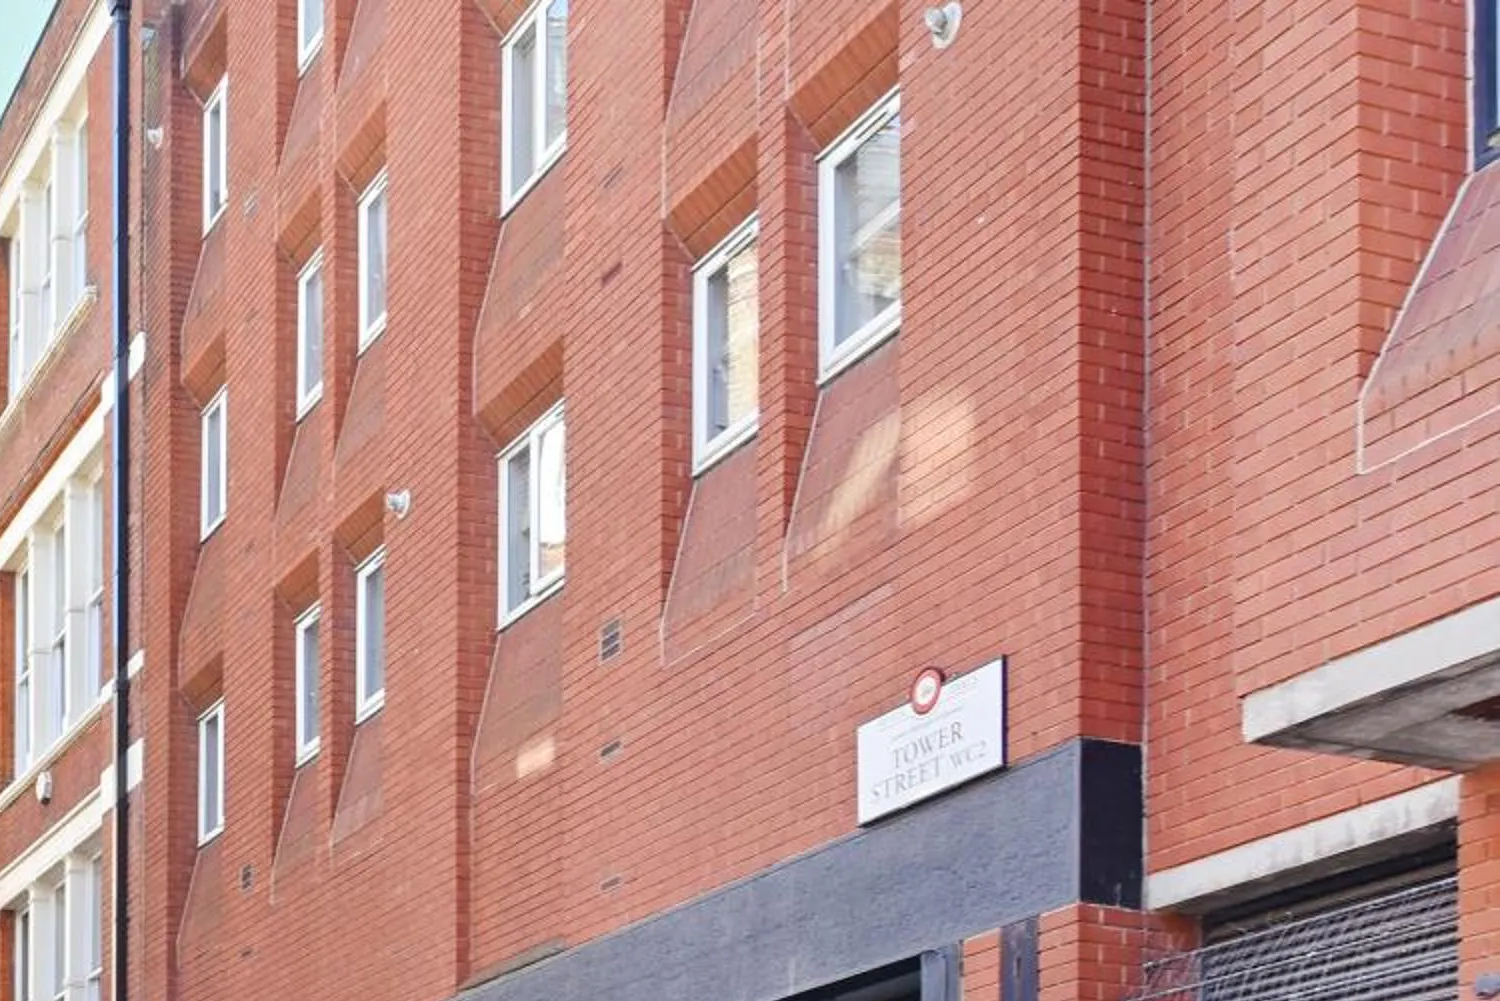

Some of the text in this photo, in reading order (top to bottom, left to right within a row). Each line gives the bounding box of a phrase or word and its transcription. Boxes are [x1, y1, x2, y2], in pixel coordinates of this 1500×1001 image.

[870, 740, 988, 799] STREET WC2
[893, 721, 963, 769] TOWER
